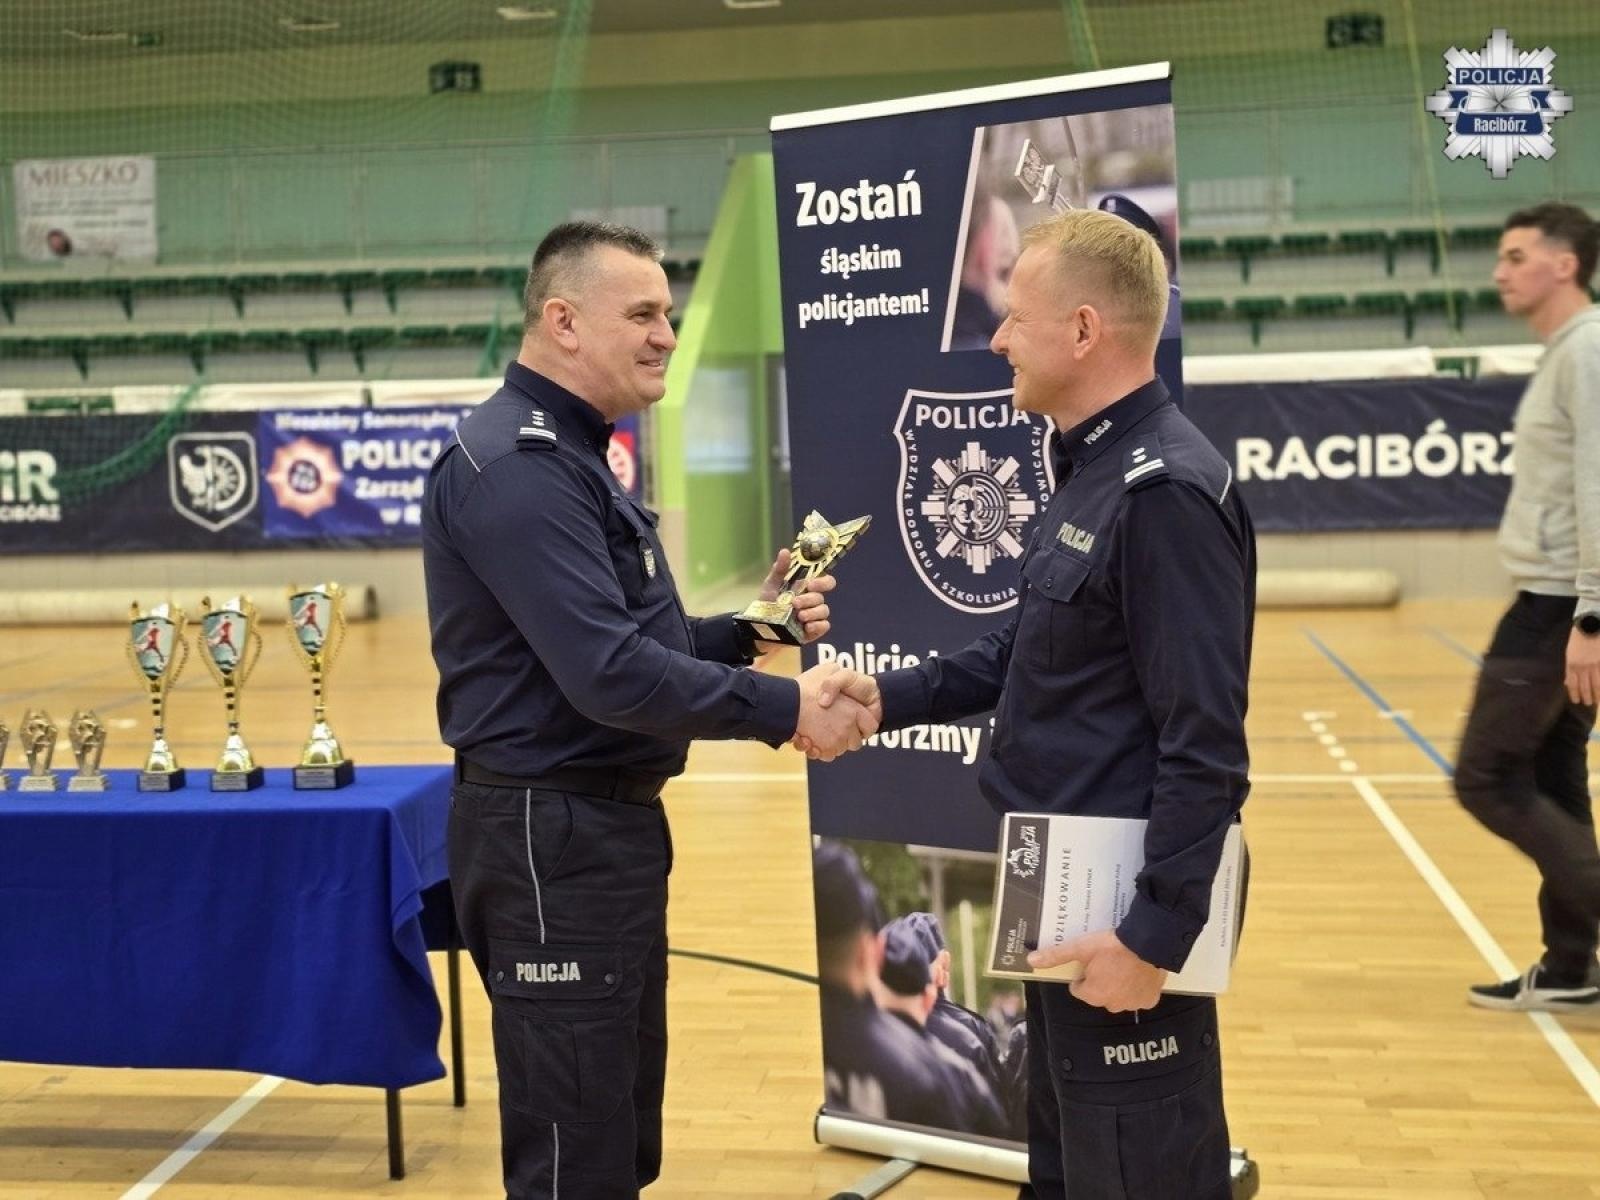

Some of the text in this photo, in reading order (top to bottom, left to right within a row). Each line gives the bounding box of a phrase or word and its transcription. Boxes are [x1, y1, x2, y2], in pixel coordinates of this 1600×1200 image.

[795, 169, 922, 227] Zostań
[820, 243, 902, 280] śląskim
[798, 288, 930, 329] policjantem!
[915, 403, 1032, 430] POLICJA
[1055, 521, 1096, 555] POLICJA
[905, 508, 934, 569] DOBORU
[940, 581, 1018, 604] SZKOLENIA
[515, 962, 581, 982] POLICJA
[1103, 1035, 1179, 1065] POLICJA
